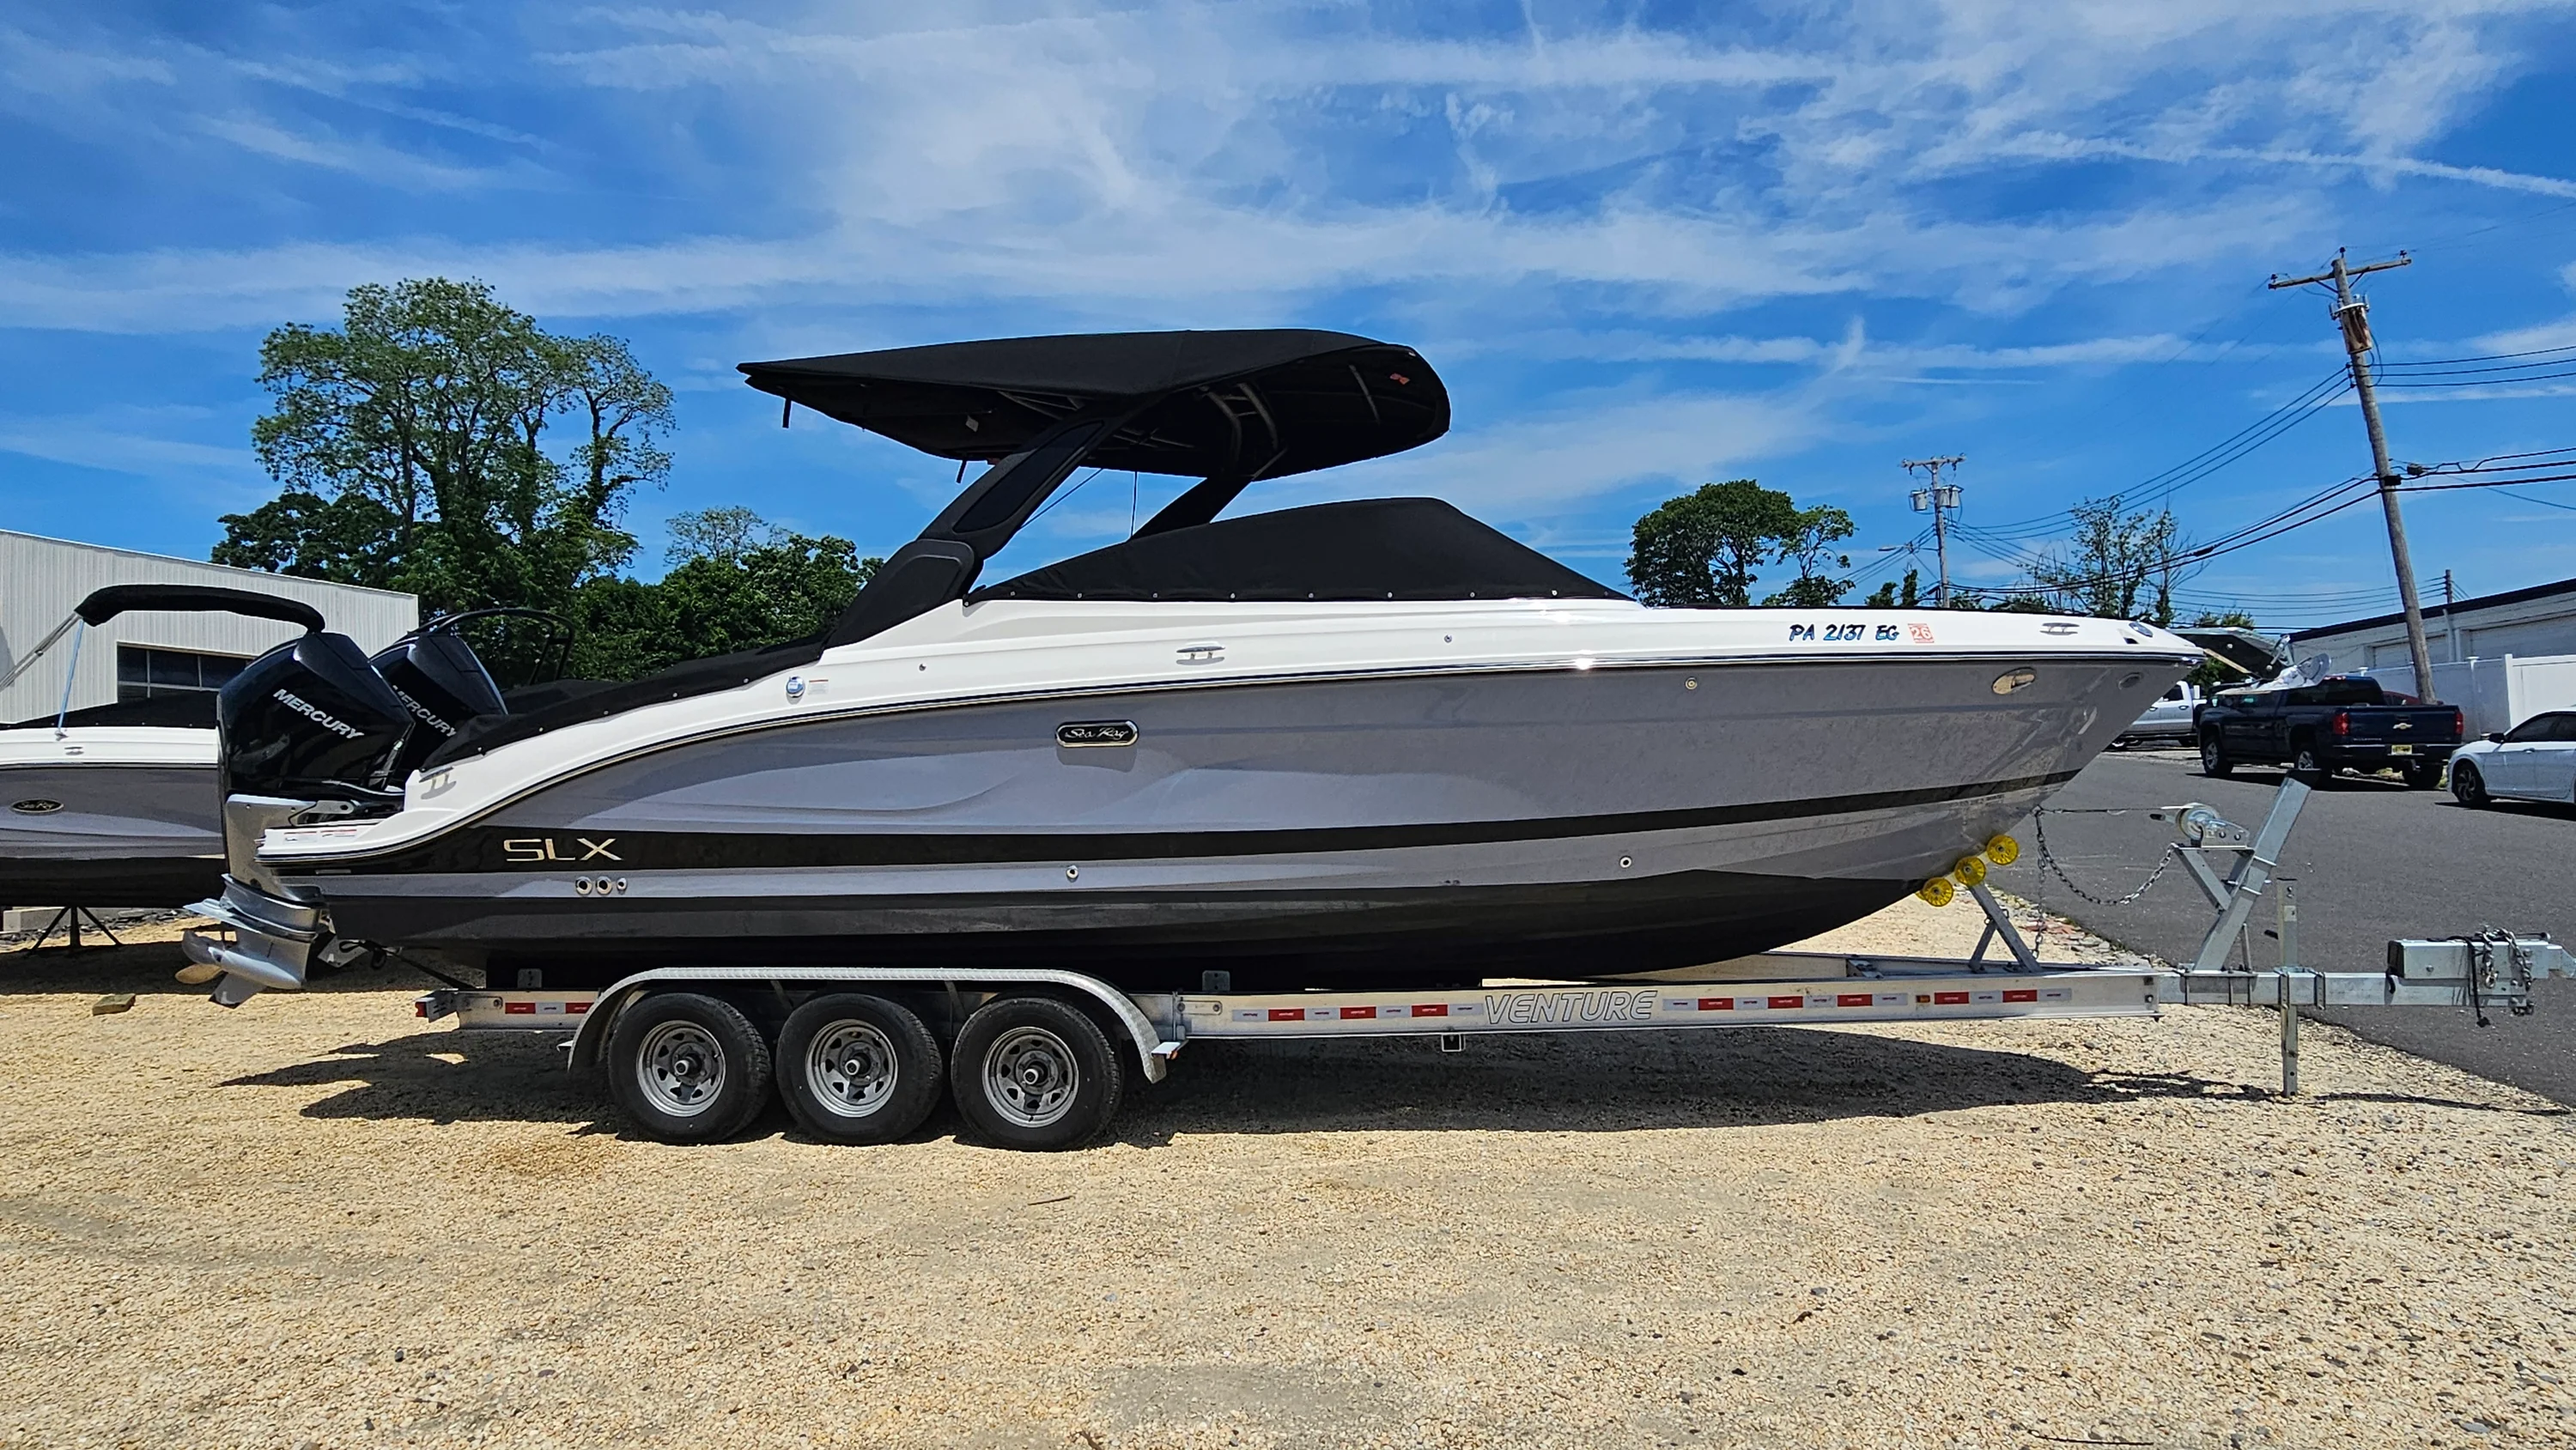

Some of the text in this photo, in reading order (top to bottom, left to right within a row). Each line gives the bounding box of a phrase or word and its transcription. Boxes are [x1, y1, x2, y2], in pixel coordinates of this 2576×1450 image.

[1789, 623, 1900, 642] PA 2137 EG
[1910, 627, 1932, 640] 26
[273, 689, 365, 739] MERCURY
[1065, 727, 1129, 741] Sea Ray
[503, 838, 623, 861] SLX
[1485, 990, 1658, 1025] VENTURE
